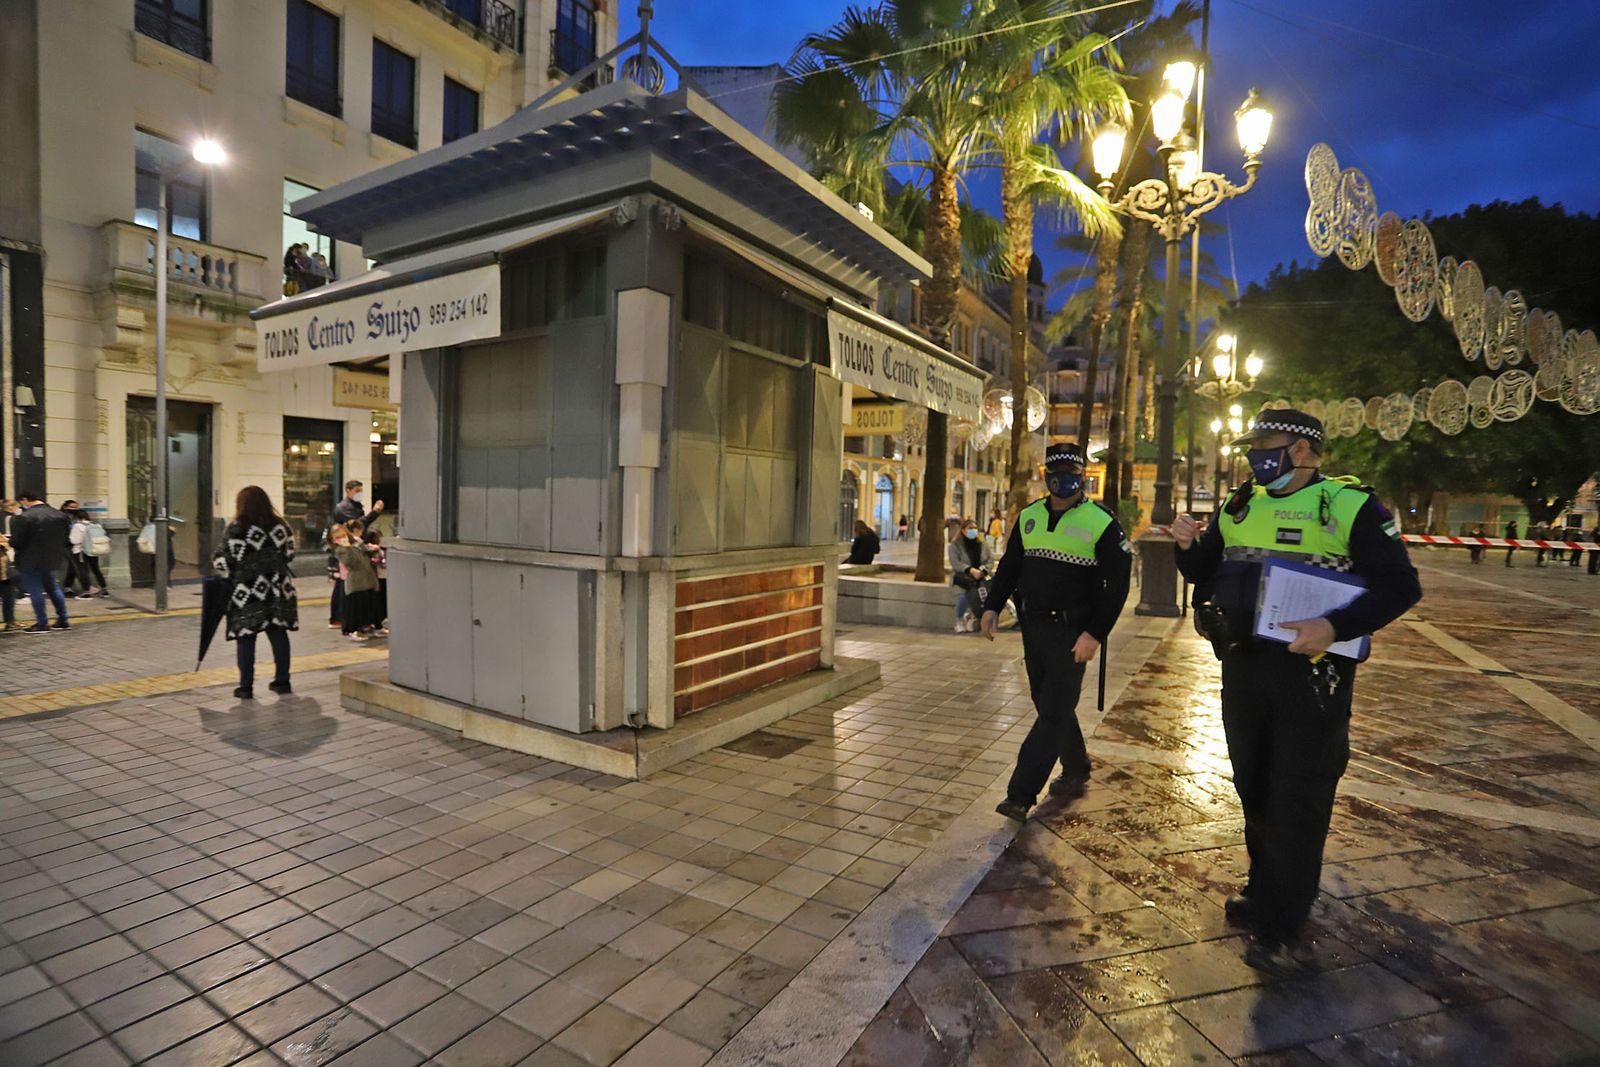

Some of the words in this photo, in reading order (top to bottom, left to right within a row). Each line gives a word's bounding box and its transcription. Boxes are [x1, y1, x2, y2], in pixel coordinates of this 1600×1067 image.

[264, 327, 299, 359] TOLDOS
[308, 315, 355, 351] Centro
[367, 300, 420, 344] Suizo
[429, 302, 447, 326] 959
[449, 299, 467, 322] 254
[470, 292, 488, 318] 142
[838, 331, 874, 377] TOLDOS
[882, 345, 920, 389] Centro
[1273, 509, 1313, 521] POLICIA
